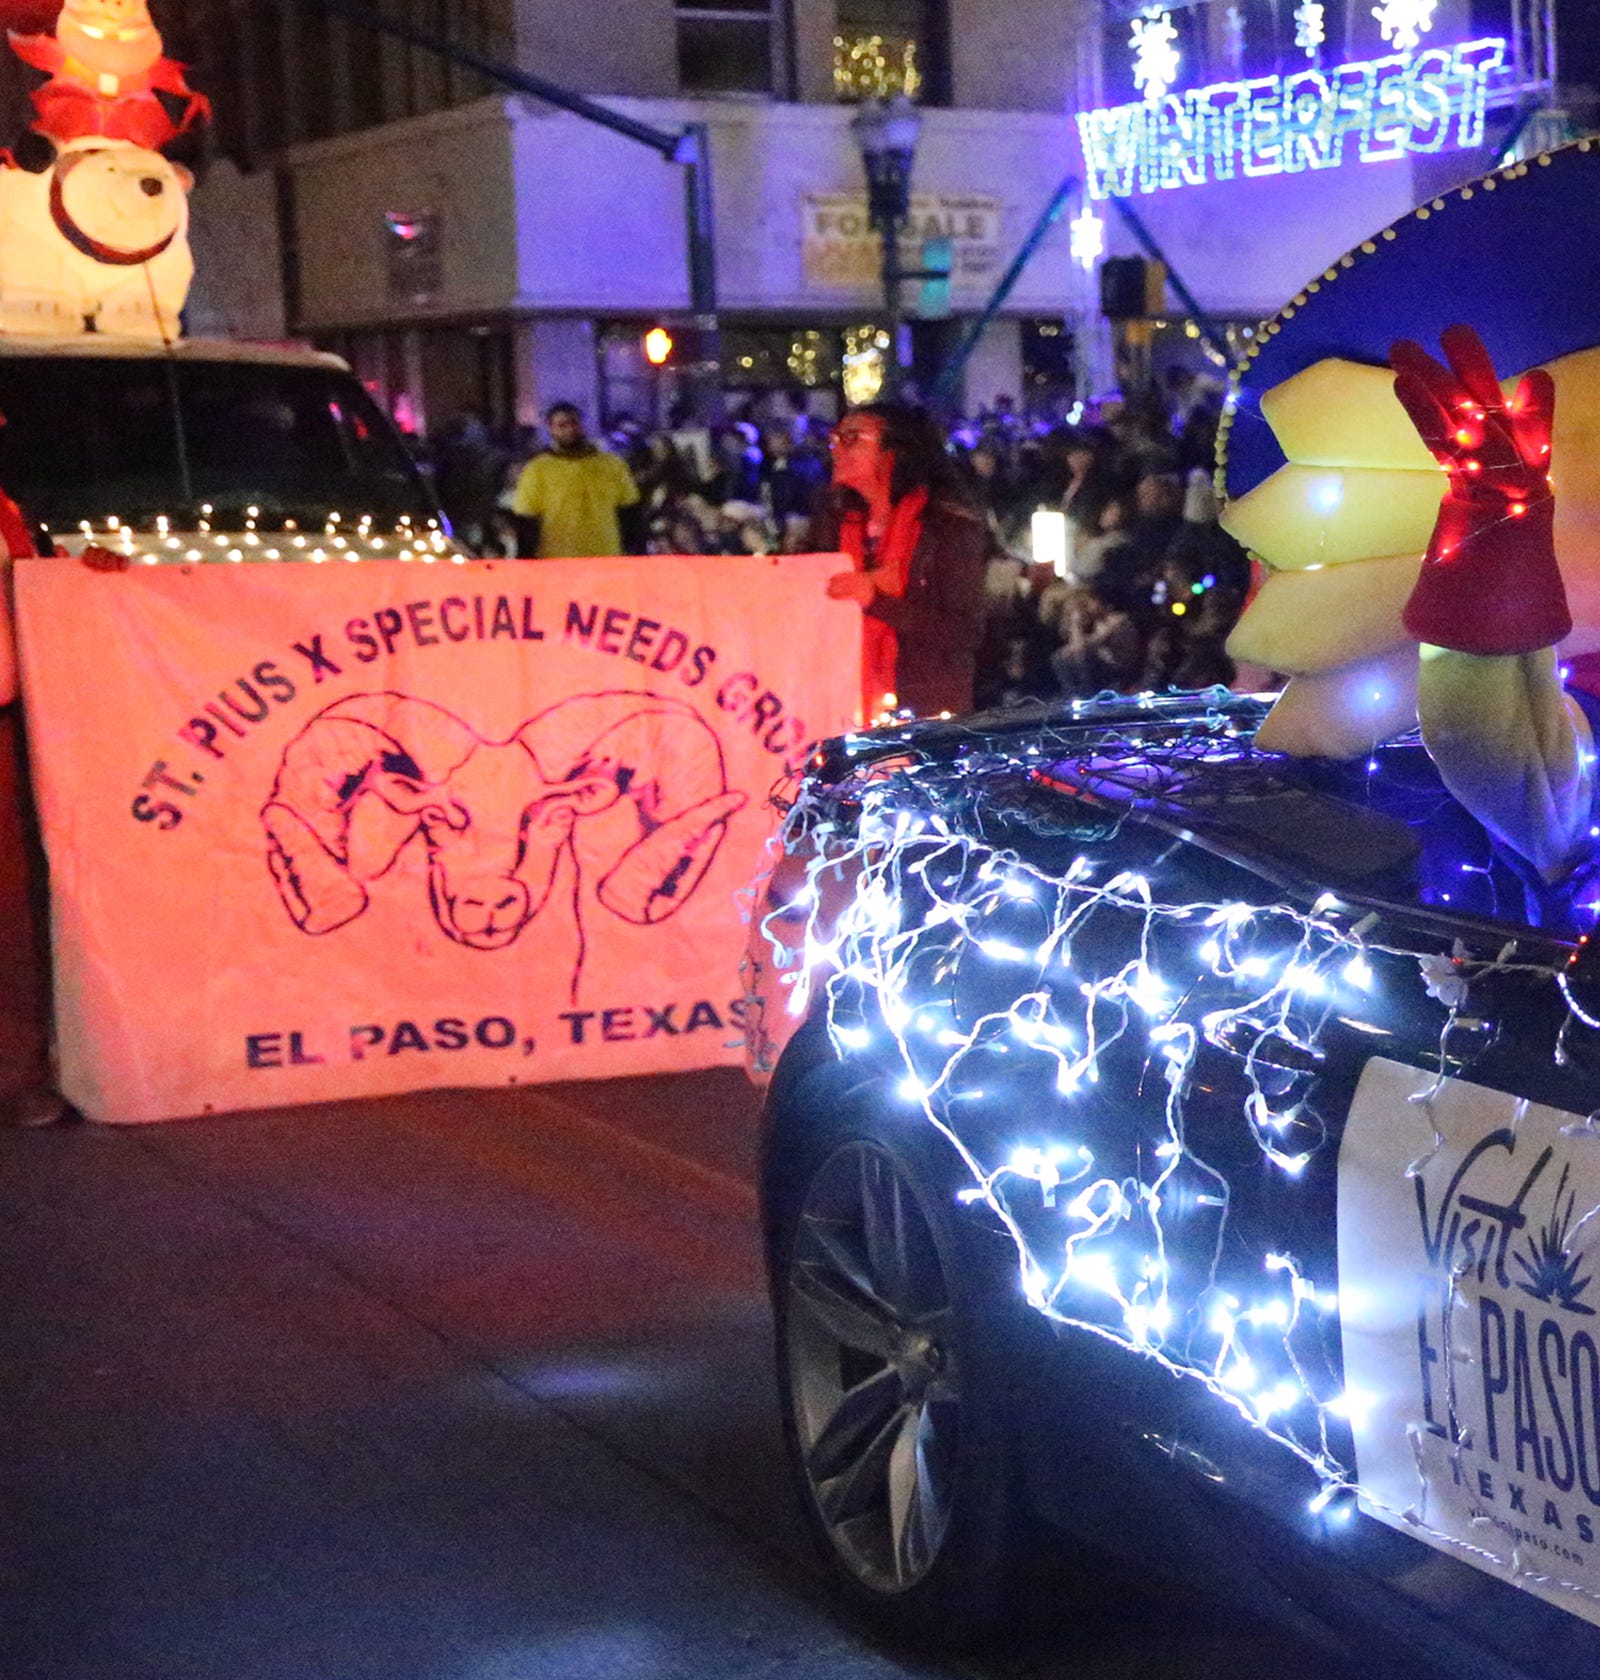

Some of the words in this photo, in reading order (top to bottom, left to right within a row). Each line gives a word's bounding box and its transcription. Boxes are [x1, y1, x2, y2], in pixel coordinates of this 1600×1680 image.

[1076, 36, 1506, 200] WINTERFEST
[899, 212, 986, 239] SALE
[131, 759, 205, 831] ST.
[177, 660, 296, 759] PIUS
[291, 633, 343, 684] X
[344, 594, 546, 664] SPECIAL
[563, 600, 717, 687] NEEDS
[245, 1030, 326, 1069] EL
[349, 1015, 536, 1061] PASO,
[1414, 1127, 1554, 1290] Visit
[1415, 1276, 1474, 1451] EL
[1447, 1454, 1595, 1545] TEXAS
